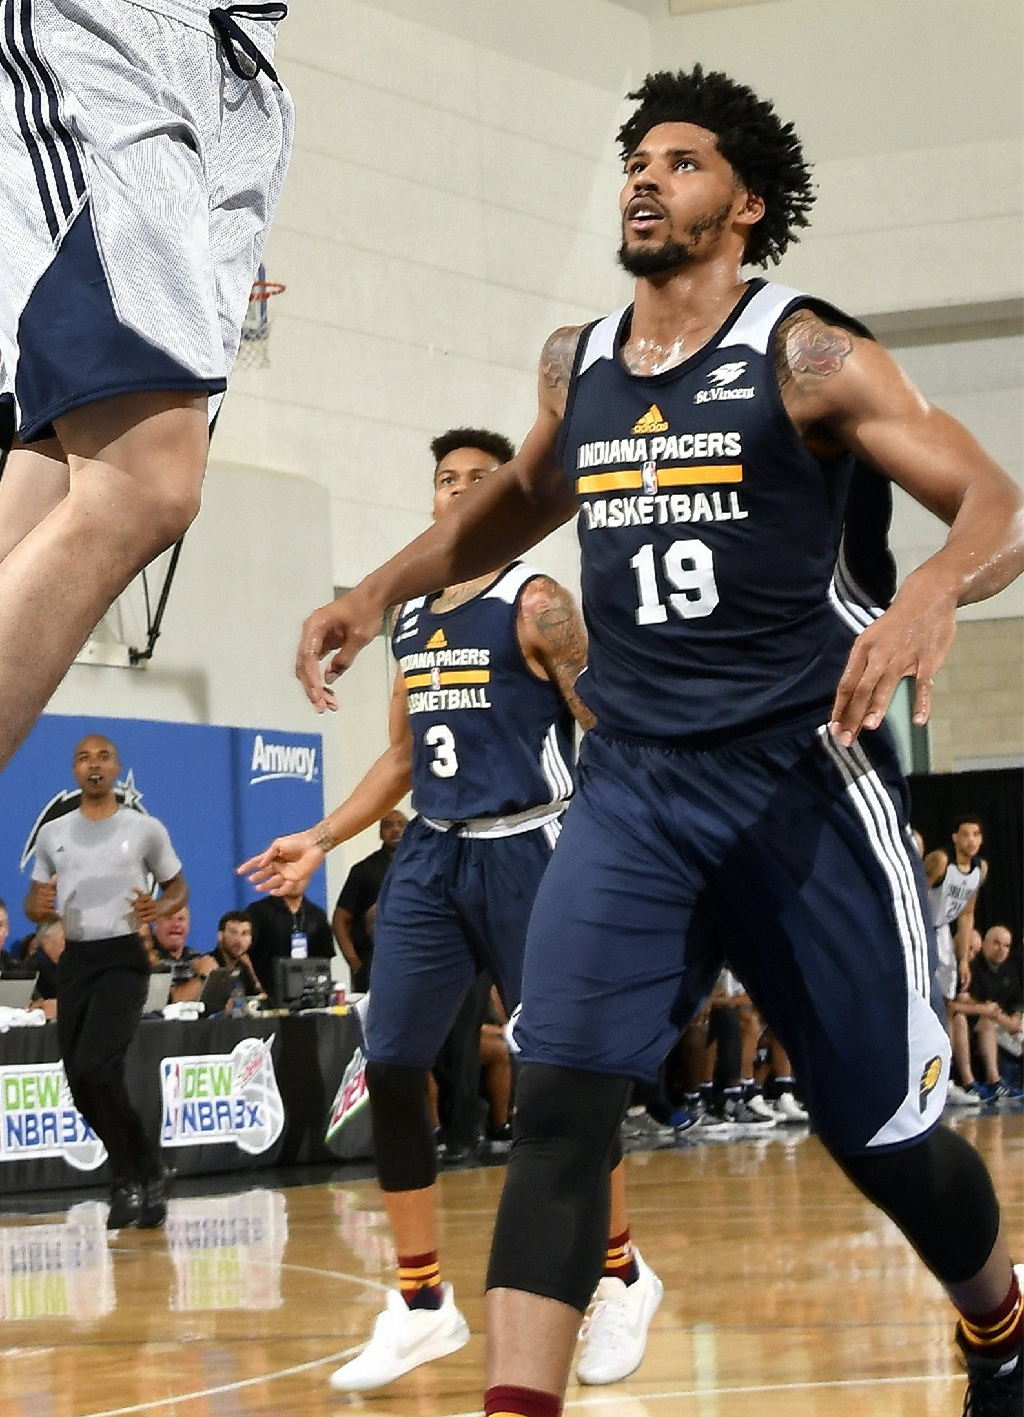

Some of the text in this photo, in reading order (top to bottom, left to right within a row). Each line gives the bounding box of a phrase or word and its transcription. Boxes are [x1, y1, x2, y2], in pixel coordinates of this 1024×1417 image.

[577, 432, 743, 470] INDIANA PACERS
[629, 539, 720, 626] 19
[435, 648, 490, 667] PACERS
[251, 733, 316, 782] Amway
[425, 724, 459, 779] 3
[5, 1074, 61, 1111] DEW
[184, 1066, 233, 1099] DEW
